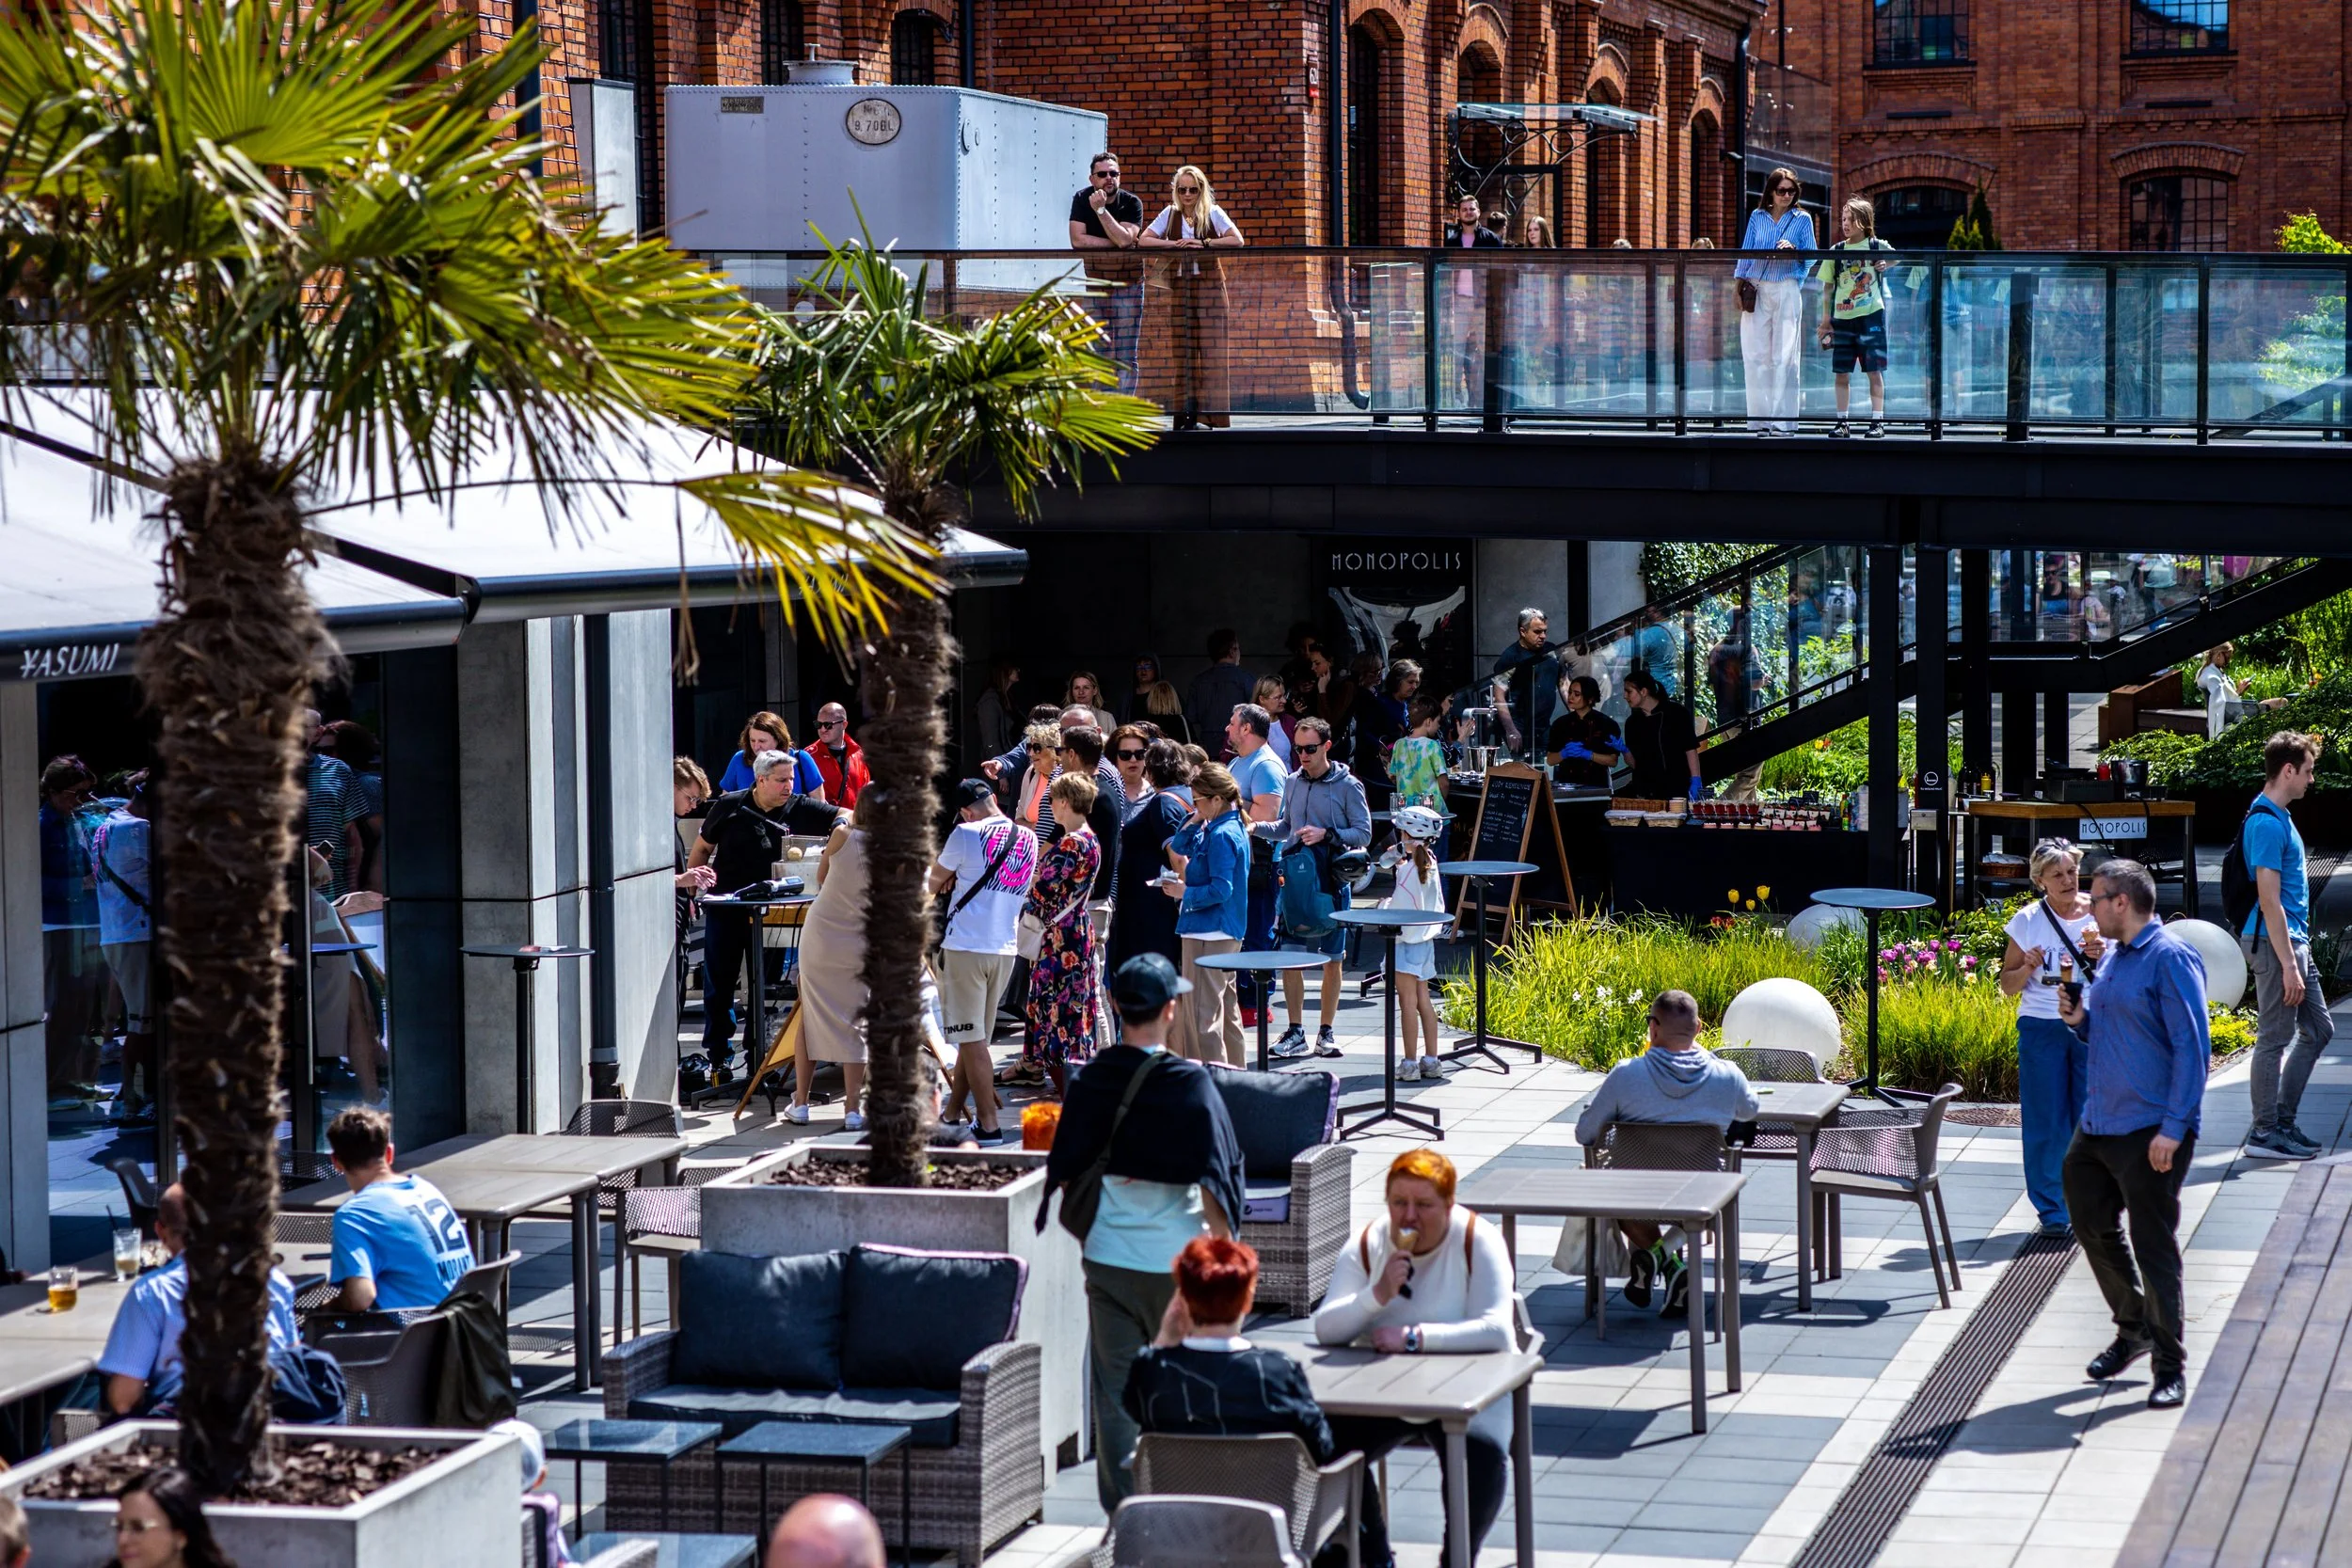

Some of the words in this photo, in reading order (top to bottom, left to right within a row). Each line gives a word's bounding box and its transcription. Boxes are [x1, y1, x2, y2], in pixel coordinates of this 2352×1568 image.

[1332, 552, 1461, 570] MONOPOLIS
[20, 642, 119, 678] YASUMI
[2081, 821, 2146, 834] MONOPOLIS
[405, 1197, 466, 1255] 12
